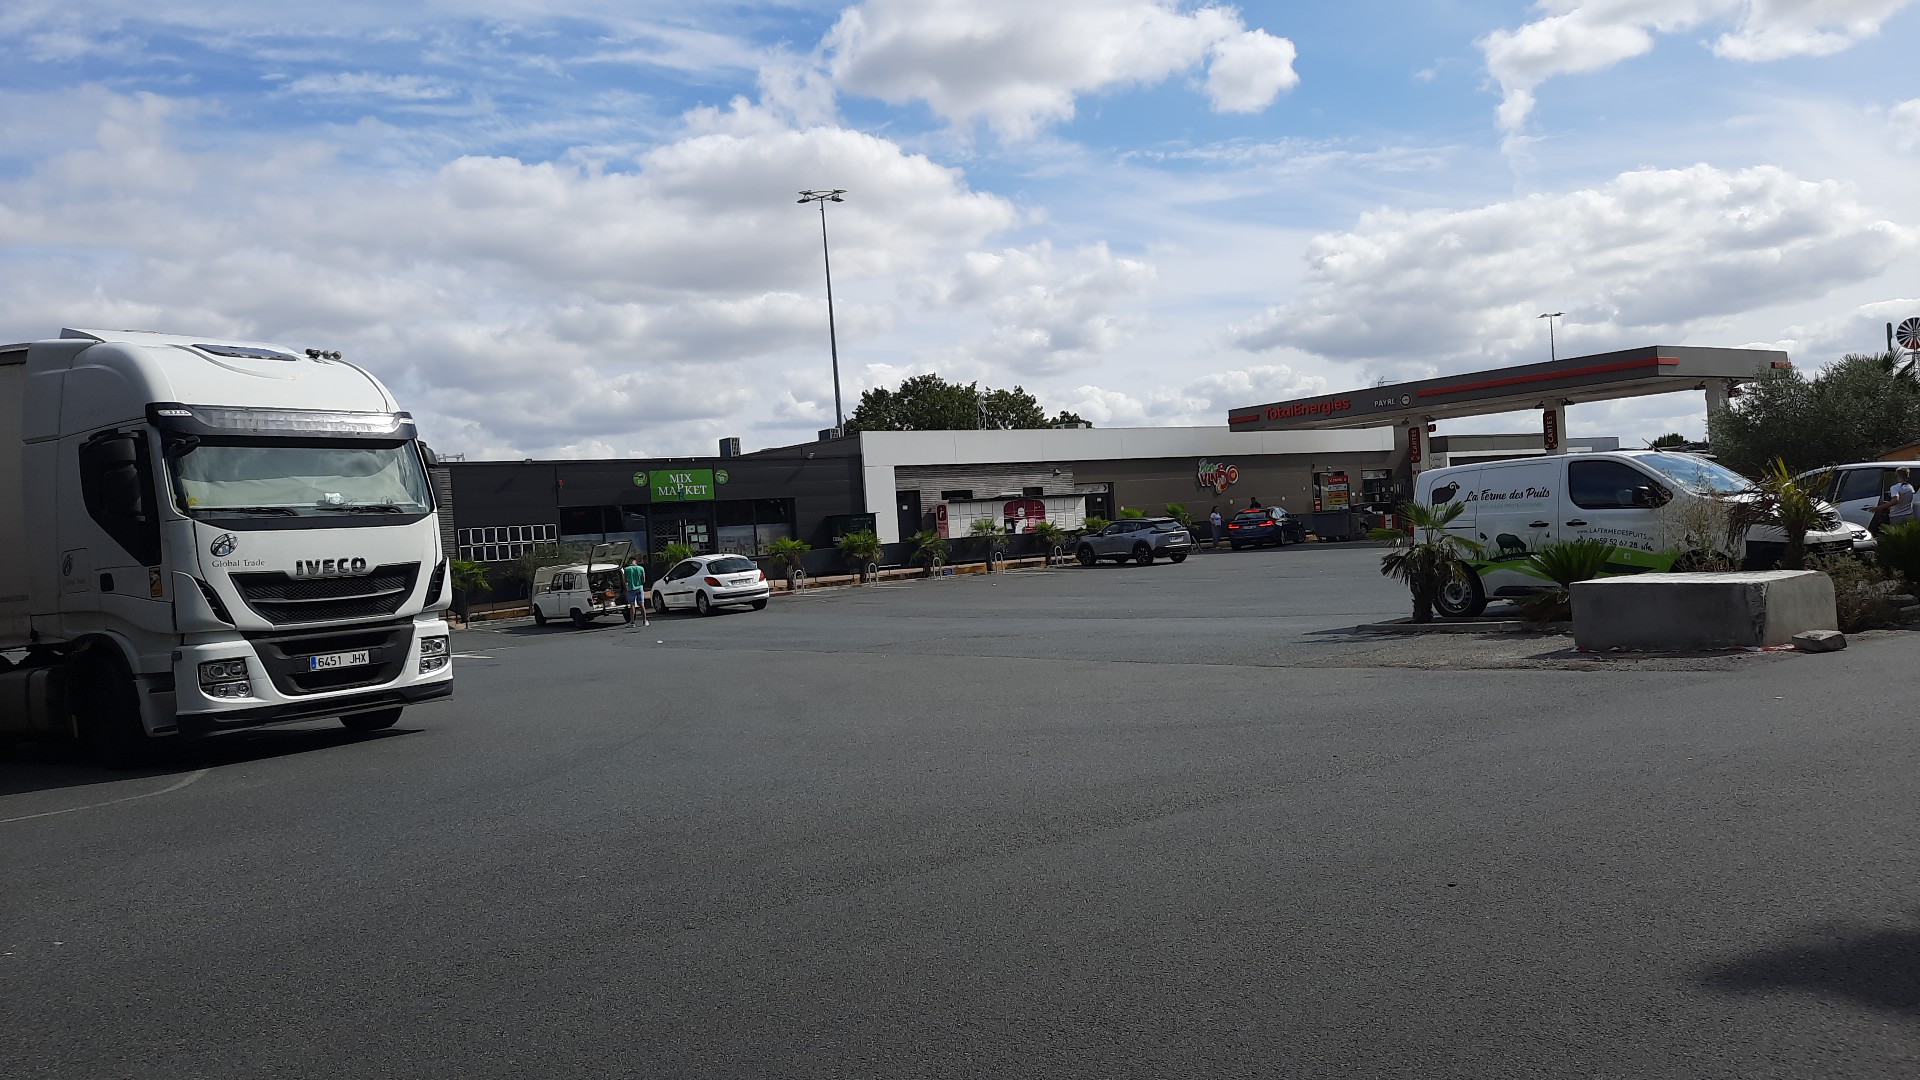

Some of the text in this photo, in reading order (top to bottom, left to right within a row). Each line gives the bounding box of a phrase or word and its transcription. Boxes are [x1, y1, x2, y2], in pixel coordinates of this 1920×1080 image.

[1263, 398, 1350, 419] TotalEnergies
[668, 474, 692, 483] MIX
[1464, 486, 1550, 502] La Ferme des Puits
[1609, 538, 1618, 546] 52
[1620, 539, 1628, 547] 67
[1629, 541, 1638, 549] 28
[211, 559, 266, 568] Global Trade
[296, 557, 367, 576] IVECO
[318, 653, 367, 667] 6451 JHX
